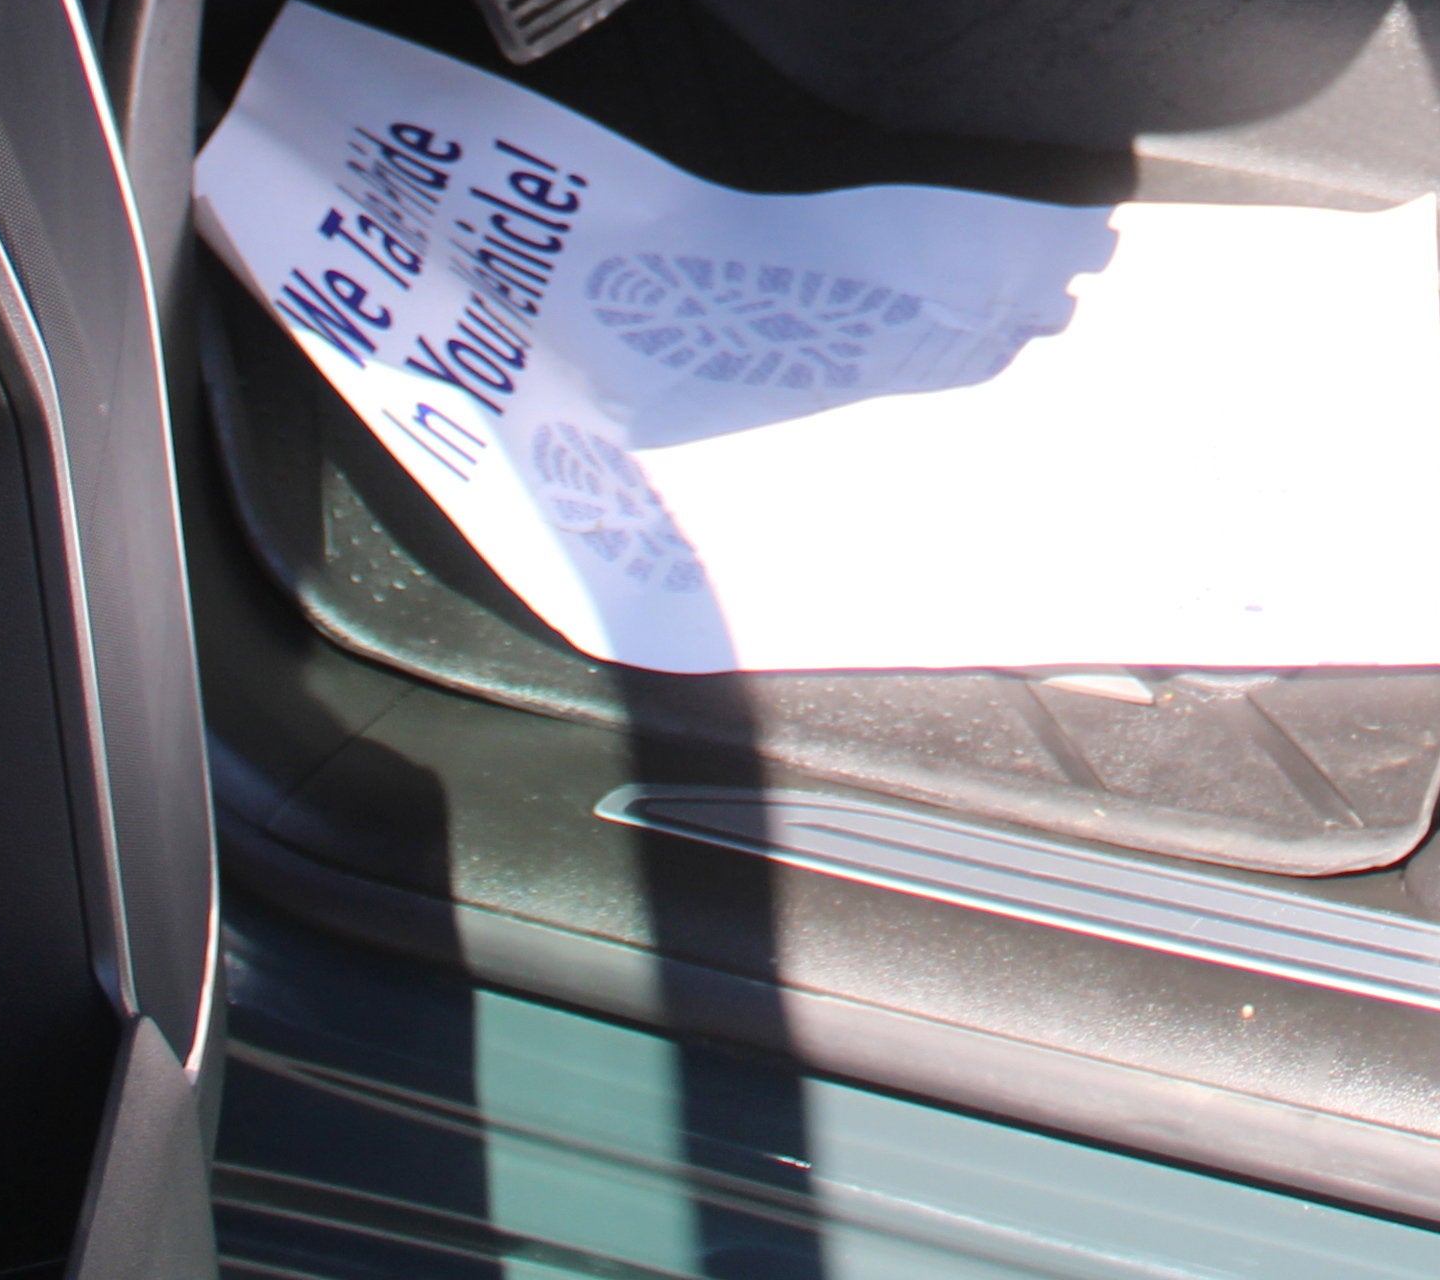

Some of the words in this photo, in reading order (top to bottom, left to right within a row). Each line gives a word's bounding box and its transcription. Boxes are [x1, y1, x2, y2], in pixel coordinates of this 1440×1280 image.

[449, 139, 589, 328] Vehicle!
[276, 267, 392, 369] We
[404, 292, 533, 416] Your
[381, 402, 488, 482] In
